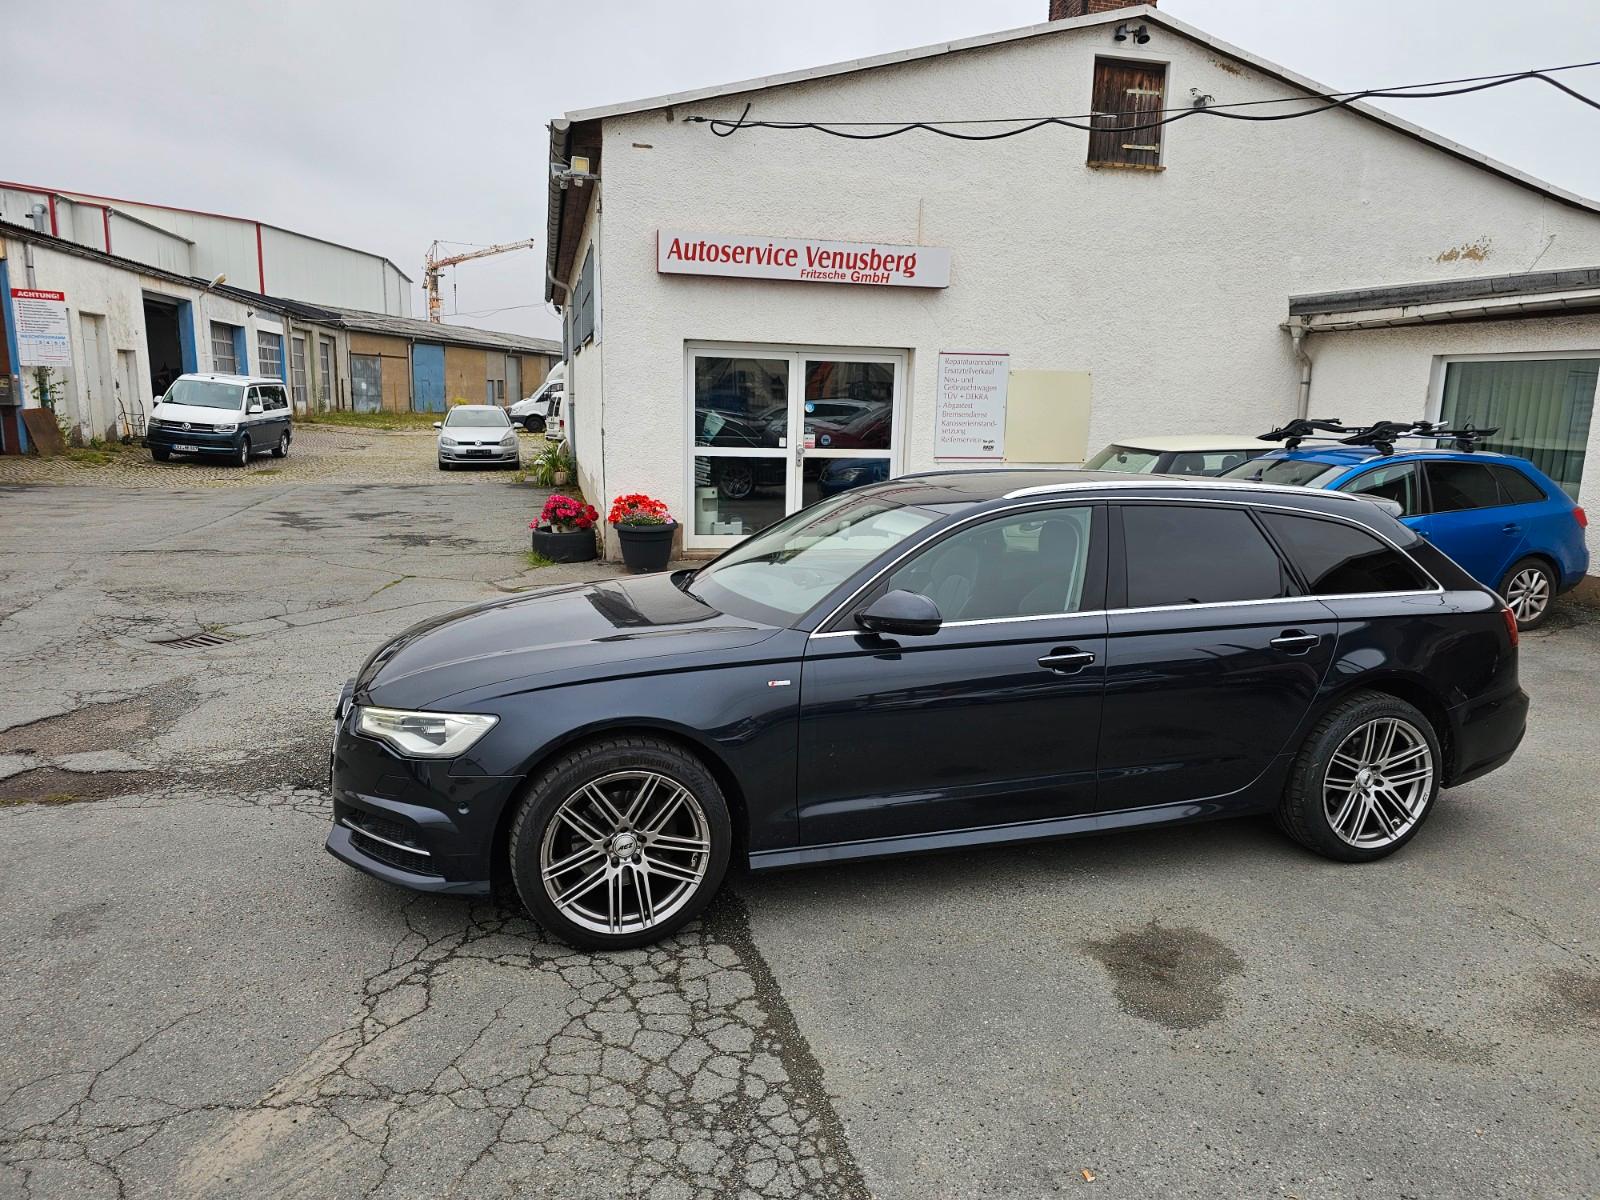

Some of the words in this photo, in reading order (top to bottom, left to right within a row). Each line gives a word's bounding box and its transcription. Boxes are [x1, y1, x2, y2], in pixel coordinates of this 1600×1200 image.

[667, 237, 798, 267] Autoservice
[805, 245, 917, 278] Venusberg
[800, 269, 847, 280] Fritzsche
[850, 271, 890, 284] GmbH
[17, 291, 60, 300] ACHTUNG!
